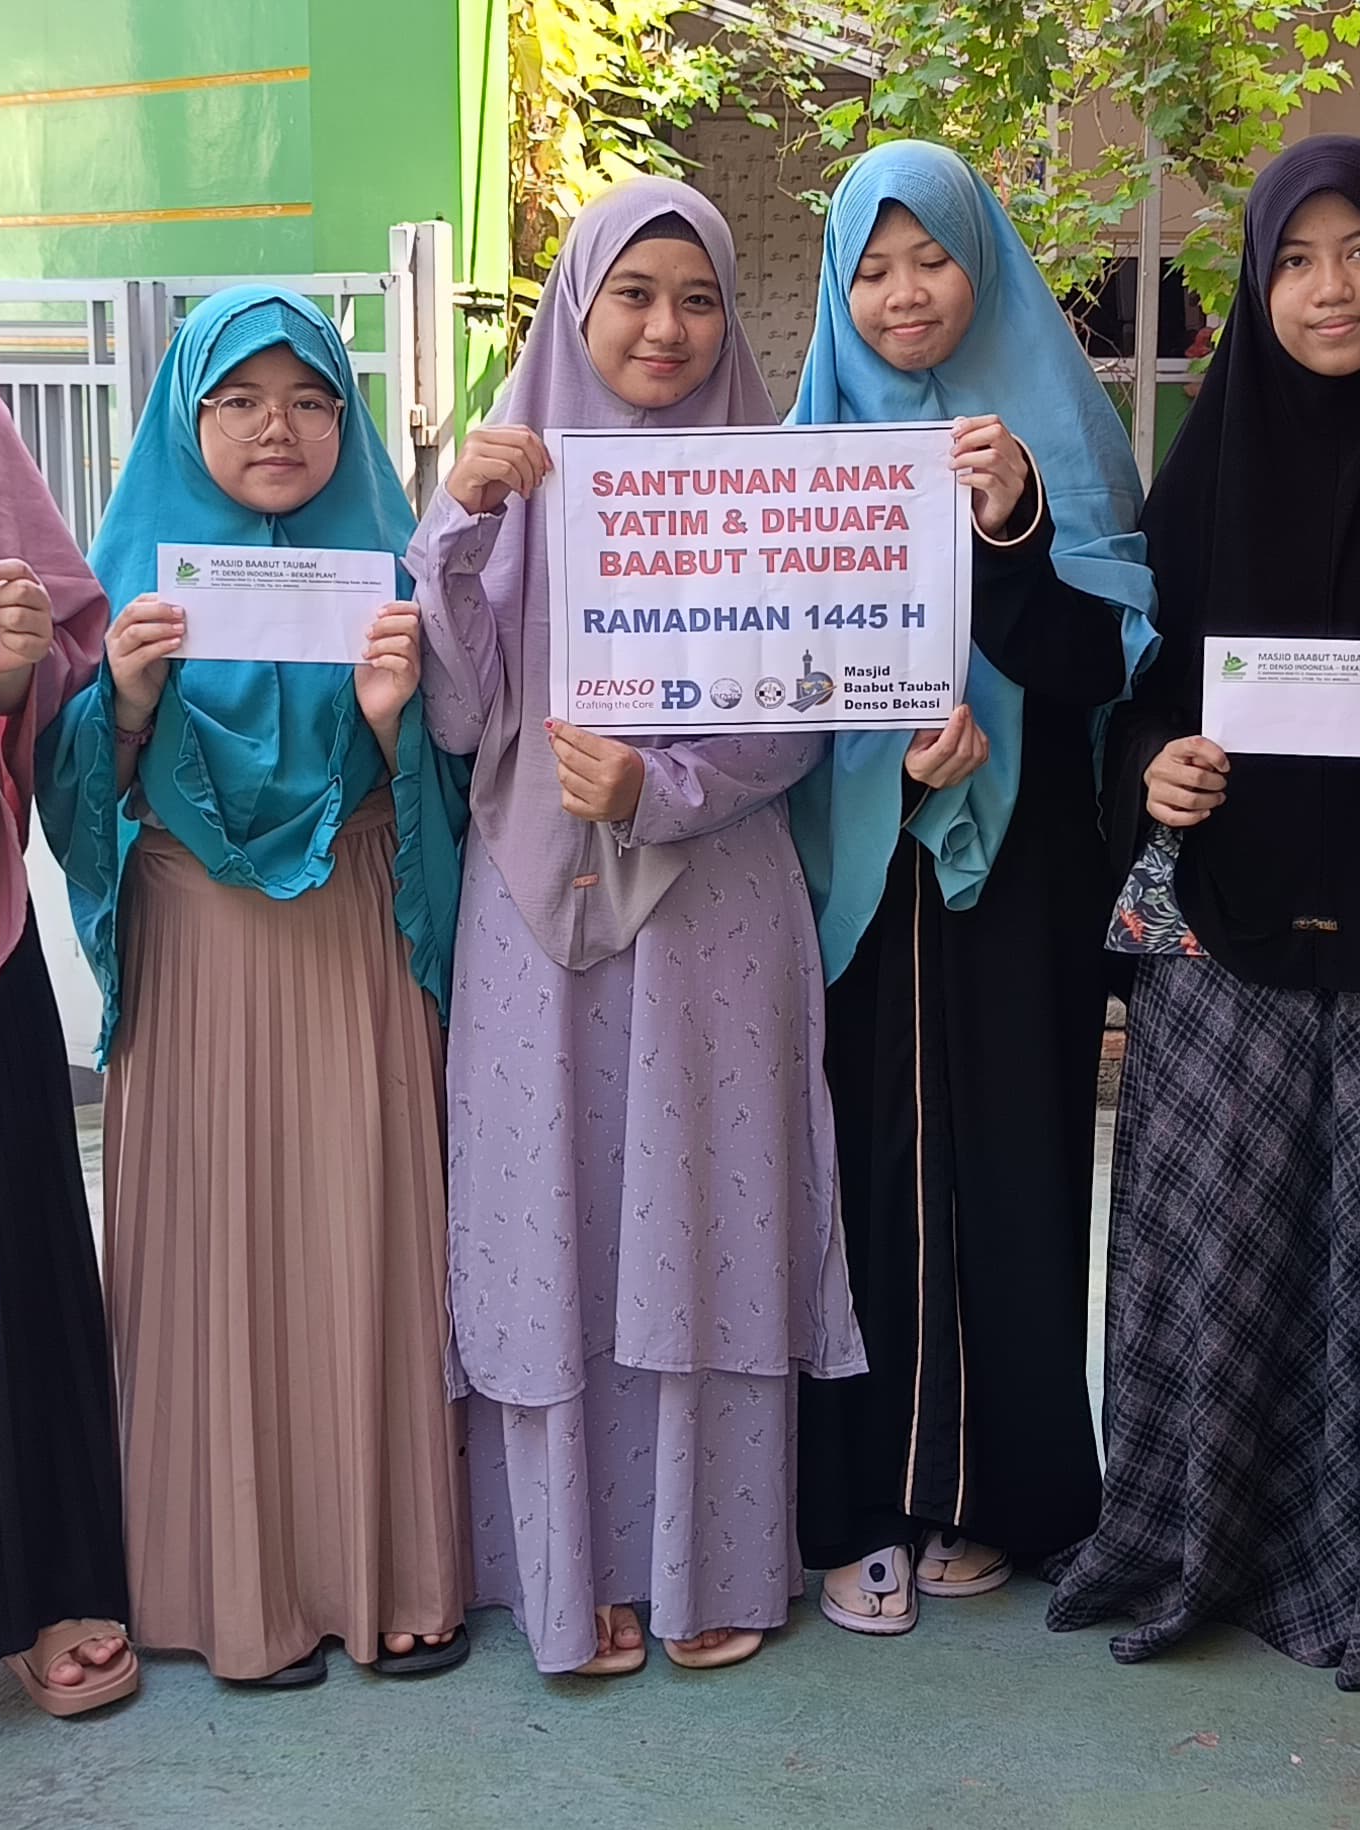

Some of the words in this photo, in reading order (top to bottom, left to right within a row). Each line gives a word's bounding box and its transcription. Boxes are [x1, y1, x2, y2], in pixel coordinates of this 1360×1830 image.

[592, 468, 796, 497] SANTUNAN
[809, 464, 915, 493] ANAK
[598, 509, 707, 536] YATIM
[722, 508, 748, 534] &
[762, 505, 909, 533] DHUAFA
[211, 559, 243, 567] MASJID
[245, 560, 280, 568] BAABUT
[282, 561, 317, 569] TAUBAH
[599, 548, 746, 577] BAABUT
[759, 545, 908, 574] TAUBAH
[583, 605, 790, 633] RAMADHAN
[804, 604, 888, 630] 1445
[902, 603, 925, 629] H
[1258, 653, 1291, 661] MASJID
[1293, 653, 1330, 661] BAABUT
[844, 665, 890, 679] Masjid
[576, 679, 655, 696] DENSO
[843, 682, 894, 693] Baabut
[898, 681, 950, 692] Taubah
[575, 700, 613, 711] Crafting
[615, 700, 630, 709] the
[632, 700, 655, 709] Core
[844, 699, 888, 710] Denso
[893, 698, 940, 709] Bekasi
